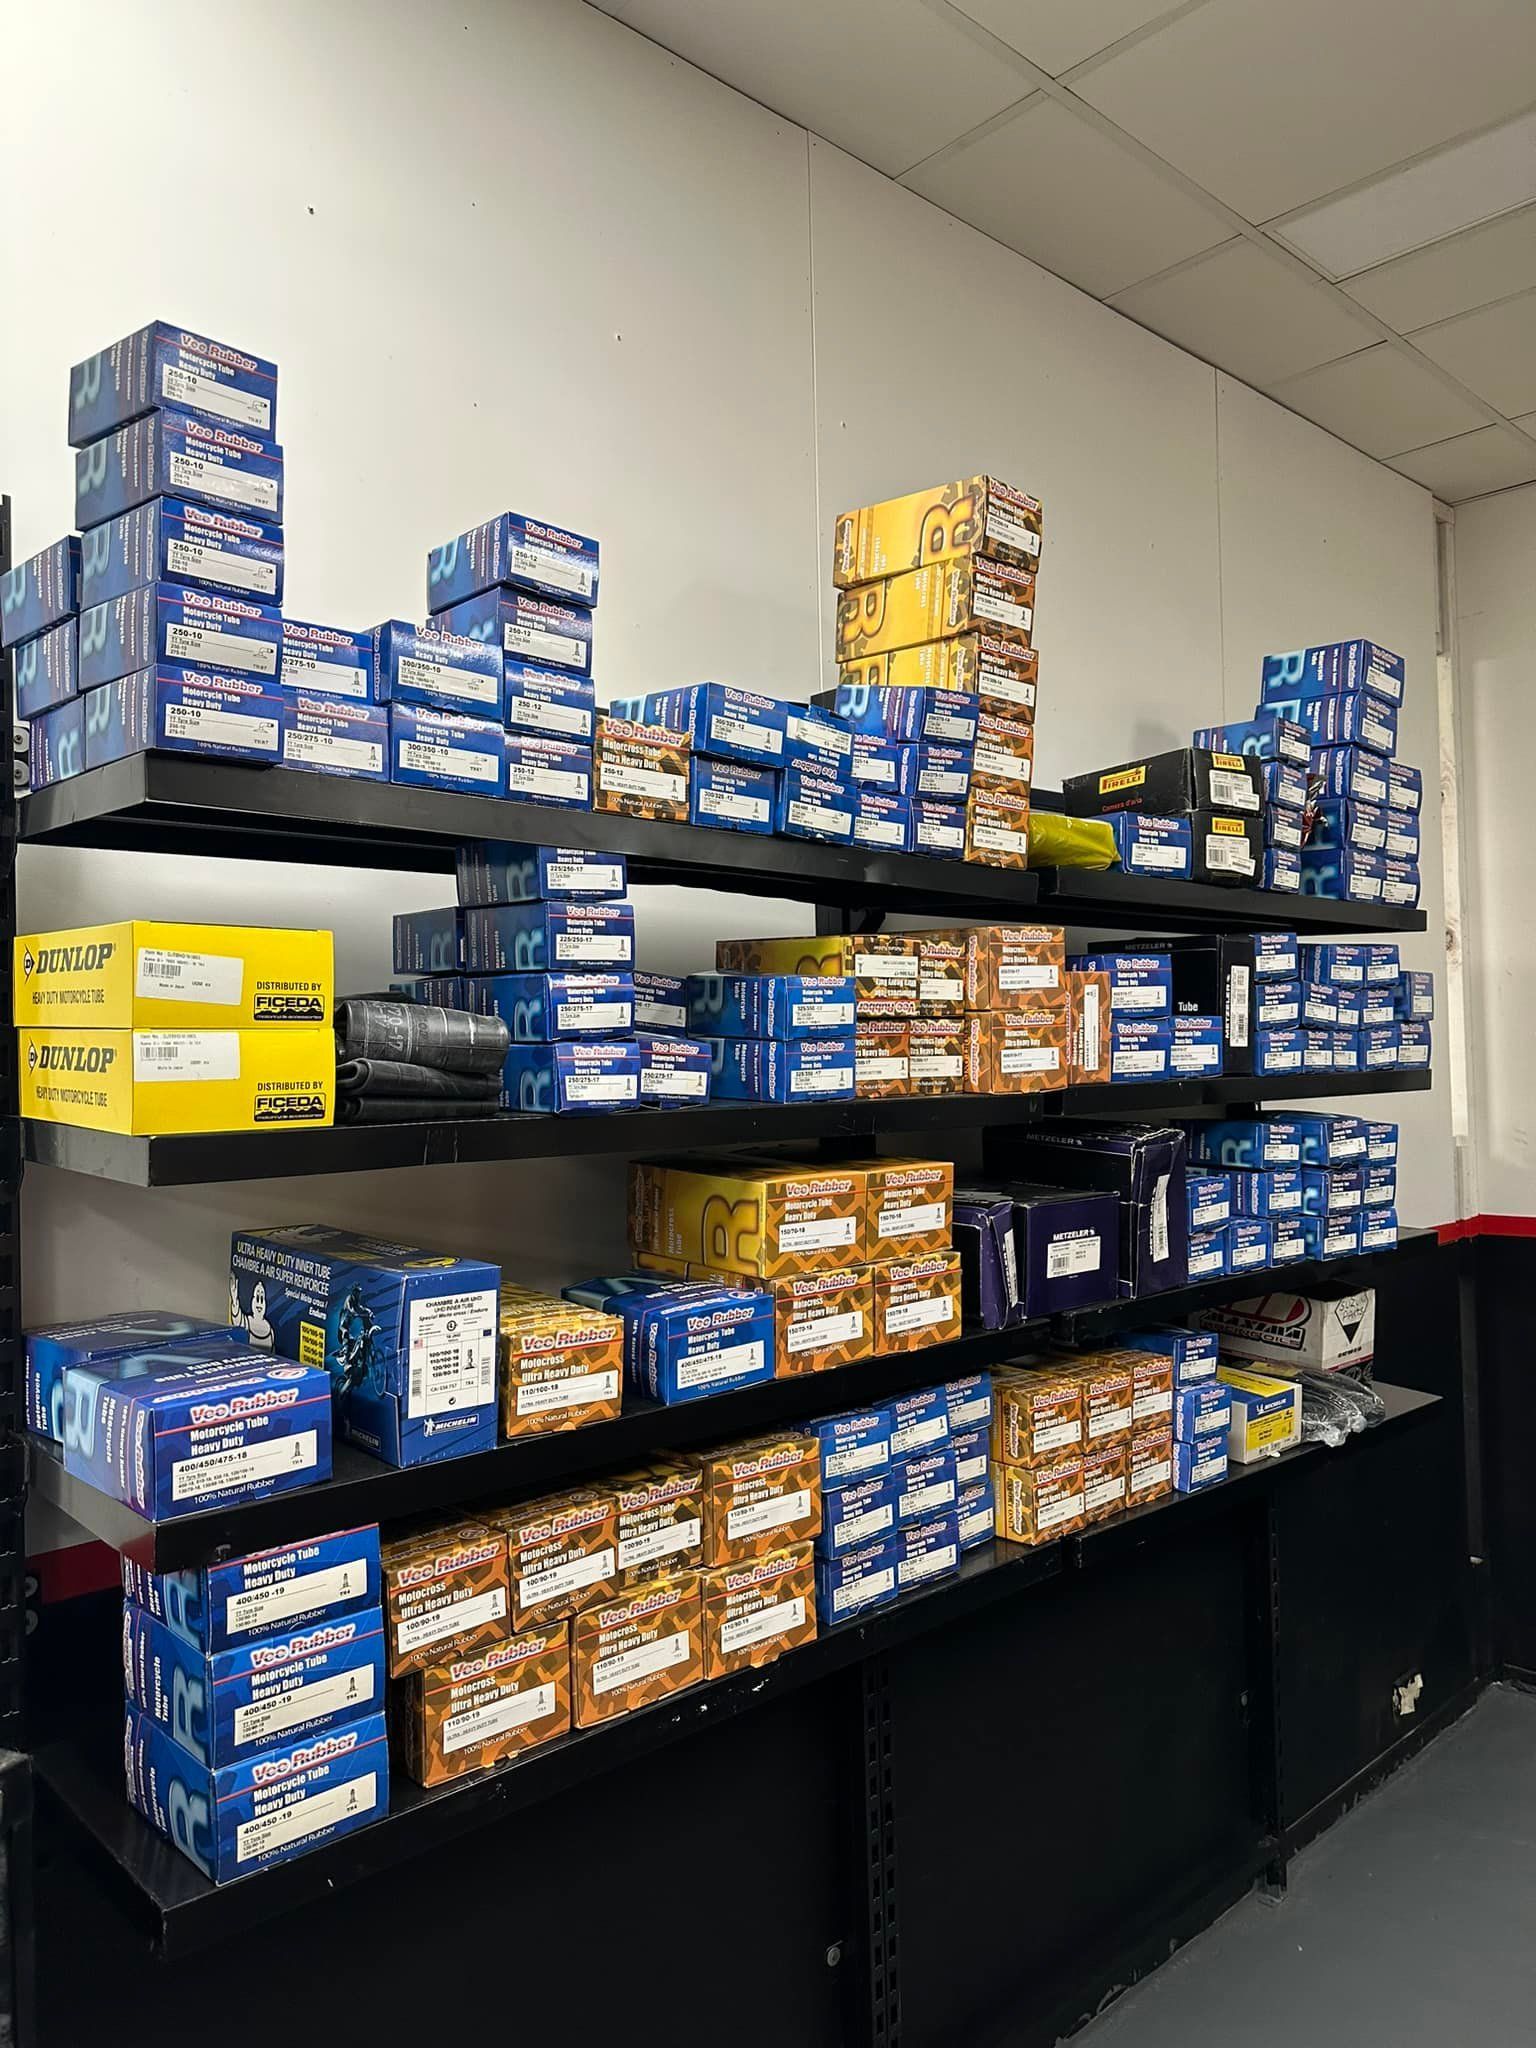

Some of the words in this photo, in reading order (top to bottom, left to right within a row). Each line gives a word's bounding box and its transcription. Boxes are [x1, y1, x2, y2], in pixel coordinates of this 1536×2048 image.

[180, 333, 207, 353] Vee
[208, 345, 257, 371] Rubber
[168, 368, 197, 385] 250-10
[186, 422, 214, 440] Vee
[215, 431, 263, 454] Rubber
[173, 456, 204, 470] 250-10
[184, 507, 213, 526] Vee
[212, 514, 262, 537] Rubber
[525, 521, 545, 537] Vee
[546, 528, 583, 549] Rubber
[173, 542, 203, 556] 250-10
[976, 557, 996, 573] Vee
[996, 565, 1032, 586] Rubber
[183, 591, 211, 608] Vee
[212, 597, 262, 618] Rubber
[183, 607, 222, 624] Motorcycle
[222, 613, 240, 626] Tube
[517, 597, 537, 611] Vee
[538, 603, 576, 620] Rubber
[172, 627, 203, 640] 250-10
[283, 624, 308, 638] Vee
[310, 629, 353, 646] Rubber
[416, 626, 439, 641] Vee
[441, 632, 484, 651] Rubber
[983, 636, 1001, 651] Vee
[1001, 641, 1035, 662] Rubber
[182, 687, 222, 702] Motorcycle
[222, 692, 241, 705] Tube
[183, 672, 211, 688] Vee
[212, 677, 263, 696] Rubber
[170, 708, 202, 719] 250-10
[182, 696, 206, 709] Heavy
[207, 700, 222, 712] Duty
[298, 699, 321, 712] Vee
[322, 703, 369, 721] Rubber
[605, 720, 632, 738] Vee
[632, 726, 684, 747] Rubber
[602, 738, 644, 754] Motorcross
[645, 746, 662, 758] Tube
[1215, 755, 1243, 769] PIRELLI
[1103, 768, 1142, 791] PIRELLI
[1215, 820, 1243, 834] PIRELLI
[566, 906, 585, 917] Vee
[586, 907, 620, 918] Rubber
[1002, 930, 1020, 940] Vee
[1021, 930, 1052, 941] Rubber
[36, 942, 113, 975] DUNLOP
[31, 990, 46, 1005] HEAVY
[47, 989, 60, 1004] DUTY
[61, 988, 91, 1004] MOTORCYCLE
[92, 988, 105, 1004] TUBE
[256, 981, 308, 992] DISTRIBUTED
[310, 981, 321, 992] BY
[256, 996, 322, 1009] FICEDA
[1178, 1002, 1198, 1012] Tube
[38, 1046, 114, 1074] DUNLOP
[574, 1047, 591, 1058] Vee
[593, 1047, 626, 1058] Rubber
[257, 1081, 309, 1091] DISTRIBUTED
[312, 1081, 322, 1091] BY
[257, 1096, 322, 1109] FICEDA
[787, 1182, 808, 1196] Vee
[809, 1180, 851, 1195] Rubber
[1053, 1229, 1089, 1241] METZELER
[233, 1254, 260, 1273] CHAMBRE
[276, 1268, 293, 1286] SUPER
[237, 1241, 256, 1257] ULTRA
[256, 1246, 276, 1263] HEAVY
[277, 1252, 295, 1269] DUTY
[295, 1258, 314, 1274] INNER
[314, 1263, 331, 1280] TUBE
[793, 1281, 816, 1295] Vee
[816, 1275, 857, 1293] Rubber
[309, 1306, 327, 1320] Enduro
[687, 1317, 711, 1331] Vee
[712, 1307, 754, 1327] Rubber
[522, 1334, 553, 1352] Vee
[556, 1327, 615, 1348] Rubber
[520, 1355, 565, 1370] Motocross
[521, 1371, 542, 1384] Ultra
[543, 1367, 568, 1380] Heavy
[570, 1364, 590, 1377] Duty
[521, 1383, 559, 1396] 110/100-18
[190, 1404, 229, 1424] Vee
[231, 1388, 299, 1413] Rubber
[190, 1421, 245, 1442] Motorcycle
[246, 1415, 269, 1430] Tube
[435, 1415, 477, 1430] MICHELIN
[190, 1441, 221, 1457] Heavy
[222, 1435, 244, 1452] Duty
[178, 1450, 248, 1474] 400/450/475-18
[733, 1462, 758, 1478] Vee
[760, 1450, 803, 1473] Rubber
[194, 1490, 217, 1504] 100%
[218, 1483, 247, 1499] Natural
[248, 1478, 276, 1492] Rubber
[621, 1491, 648, 1511] Vee
[649, 1477, 698, 1500] Rubber
[520, 1526, 551, 1546] Vee
[552, 1505, 609, 1533] Rubber
[244, 1553, 295, 1576] Motorcycle
[297, 1546, 320, 1564] Tube
[398, 1565, 433, 1585] Vee
[435, 1544, 499, 1575] Rubber
[244, 1572, 274, 1590] Heavy
[275, 1566, 296, 1583] Duty
[399, 1581, 446, 1606] Motocross
[401, 1602, 422, 1619] Ultra
[425, 1592, 451, 1613] Heavy
[452, 1586, 473, 1604] Duty
[600, 1610, 627, 1628] Vee
[629, 1589, 681, 1617] Rubber
[251, 1645, 288, 1667] Vee
[290, 1624, 355, 1653] Rubber
[251, 1662, 302, 1686] Motorcycle
[304, 1653, 328, 1669] Tube
[451, 1660, 484, 1681] Vee
[486, 1638, 545, 1669] Rubber
[451, 1674, 496, 1699] Motocross
[253, 1759, 290, 1782] Vee
[291, 1732, 357, 1764] Rubber
[254, 1775, 305, 1802] Motorcycle
[306, 1764, 330, 1782] Tube
[255, 1796, 284, 1816] Heavy
[286, 1788, 306, 1807] Duty
[257, 1849, 280, 1863] 100%
[281, 1838, 308, 1855] Natural
[309, 1826, 335, 1843] Rubber
